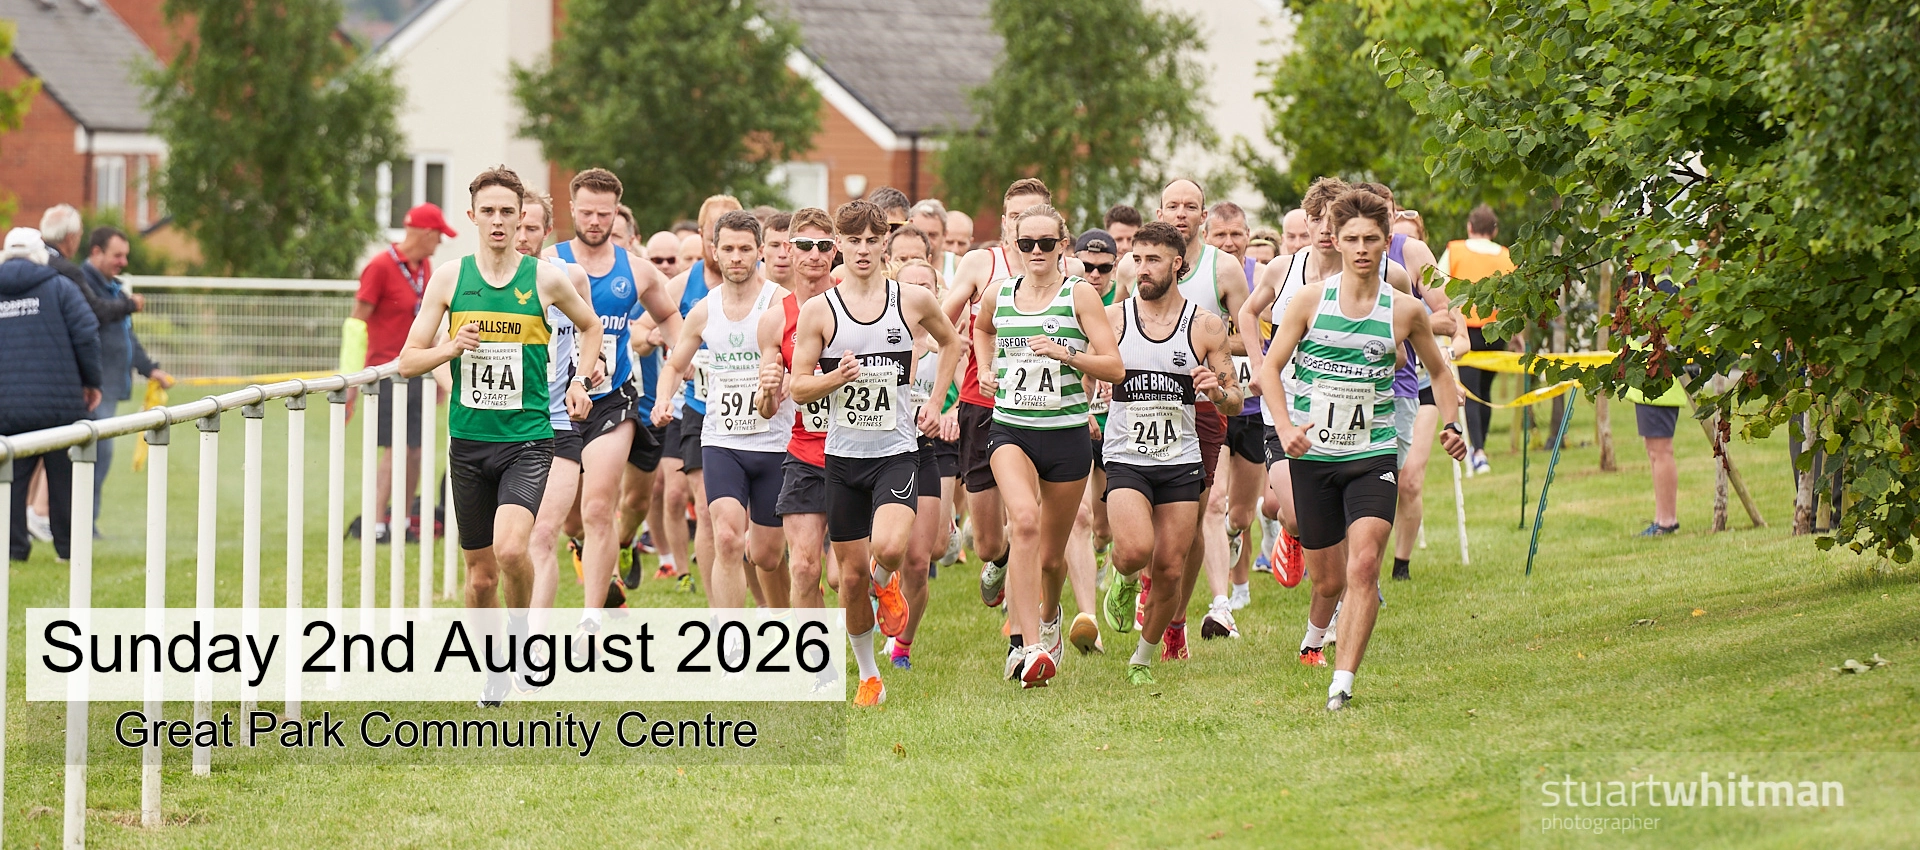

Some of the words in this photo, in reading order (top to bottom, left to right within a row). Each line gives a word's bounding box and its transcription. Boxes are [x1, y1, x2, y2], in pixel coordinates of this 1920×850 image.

[0, 297, 40, 312] ORPETH
[470, 320, 521, 335] ALLSEND
[998, 338, 1029, 348] GOSFOR
[715, 351, 761, 362] HEATON
[1239, 362, 1251, 383] A
[1303, 356, 1352, 375] GOSFORTH
[471, 362, 495, 390] 14
[498, 364, 516, 391] A
[1014, 367, 1027, 392] 2
[1038, 367, 1055, 393] A
[1124, 373, 1149, 392] TYNE
[1150, 372, 1185, 396] BRIDGE
[1317, 383, 1346, 392] GOSFORTH
[1323, 391, 1345, 399] SUMMER
[482, 392, 509, 401] START
[843, 385, 871, 412] 23
[874, 386, 891, 412] A
[1022, 394, 1048, 402] START
[1132, 392, 1178, 401] HARRIERS
[720, 392, 743, 417] 59
[734, 418, 757, 426] START
[857, 414, 883, 422] START
[1327, 402, 1335, 429] 1
[1348, 403, 1365, 430] A
[1133, 420, 1160, 446] 24
[1163, 419, 1178, 445] A
[1330, 432, 1357, 441] START
